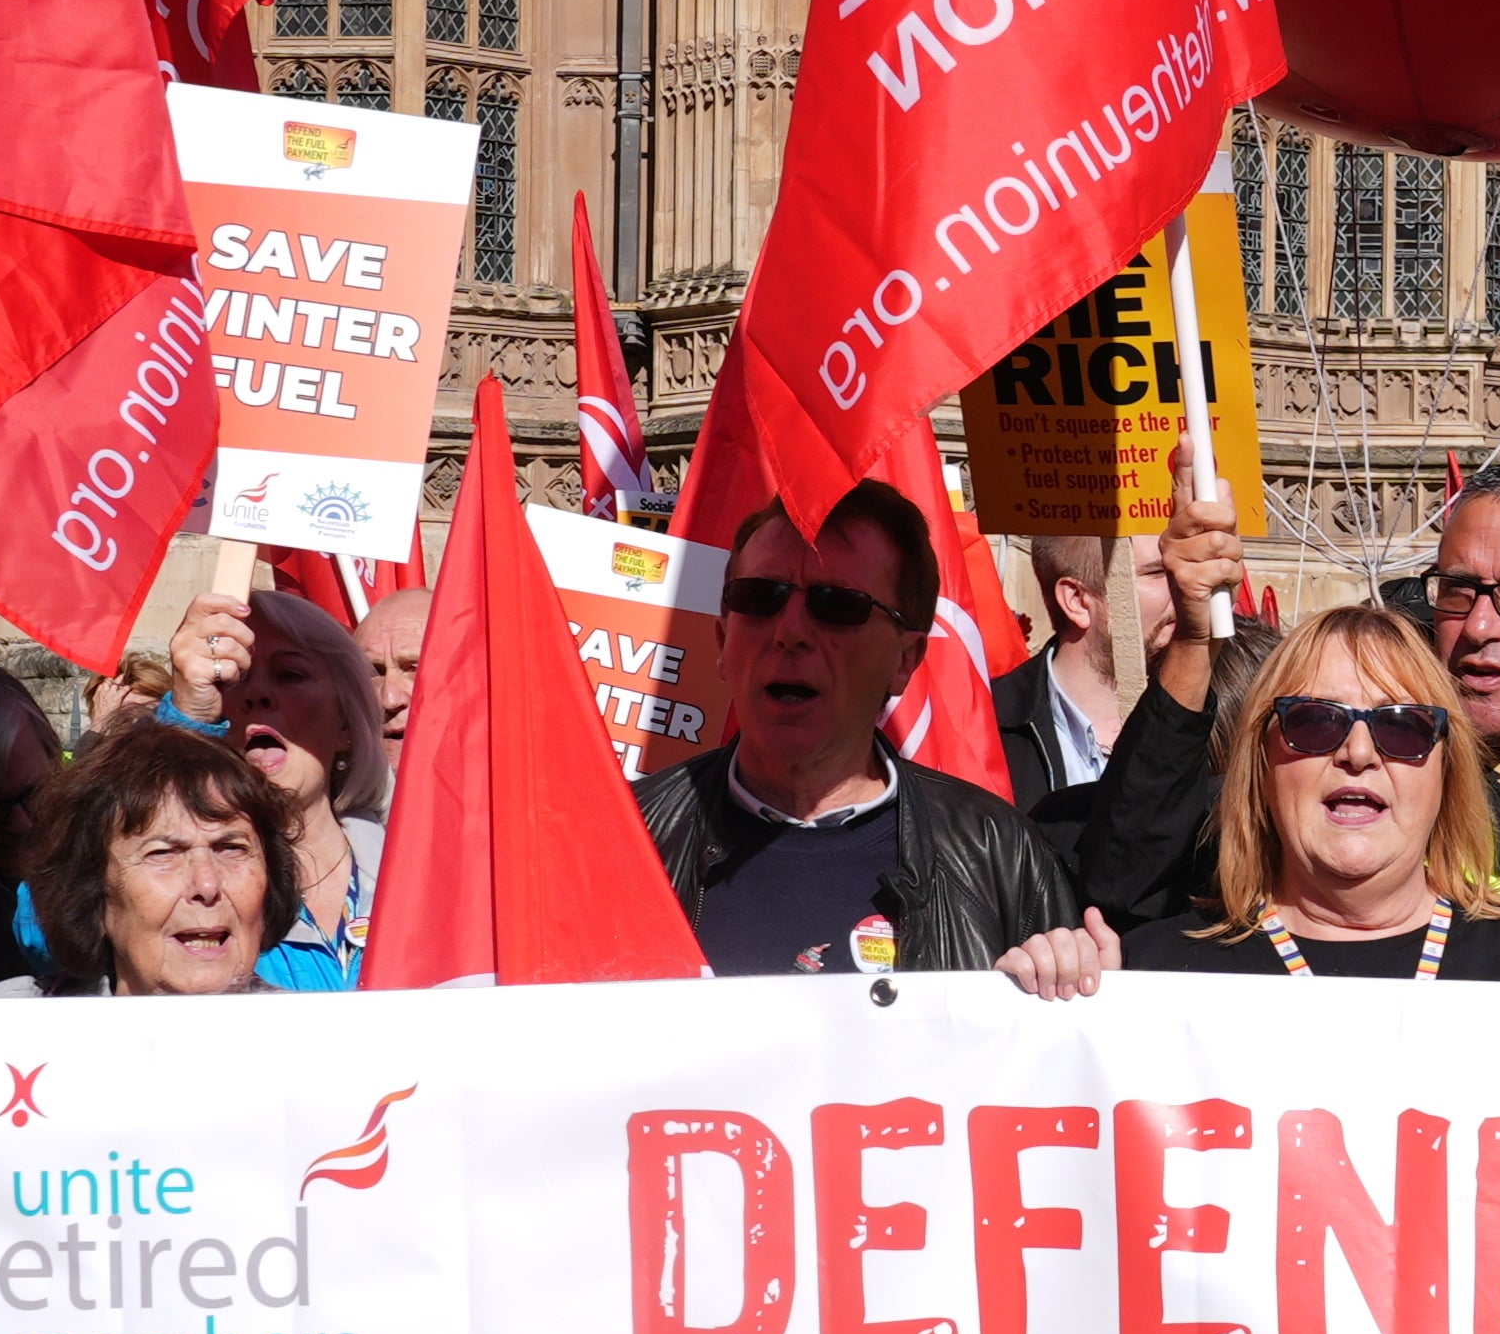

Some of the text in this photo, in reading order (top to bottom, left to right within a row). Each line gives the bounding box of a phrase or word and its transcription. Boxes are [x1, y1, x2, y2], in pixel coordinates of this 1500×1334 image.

[207, 222, 390, 292] SAVE
[992, 339, 1218, 406] RICH
[211, 354, 358, 422] FUEL
[1056, 412, 1220, 437] squeeze the pr
[1020, 443, 1158, 465] Protect winter
[1023, 468, 1139, 494] fuel support
[222, 502, 270, 523] unite
[1028, 498, 1172, 523] Scrap two child
[11, 1151, 196, 1217] unite
